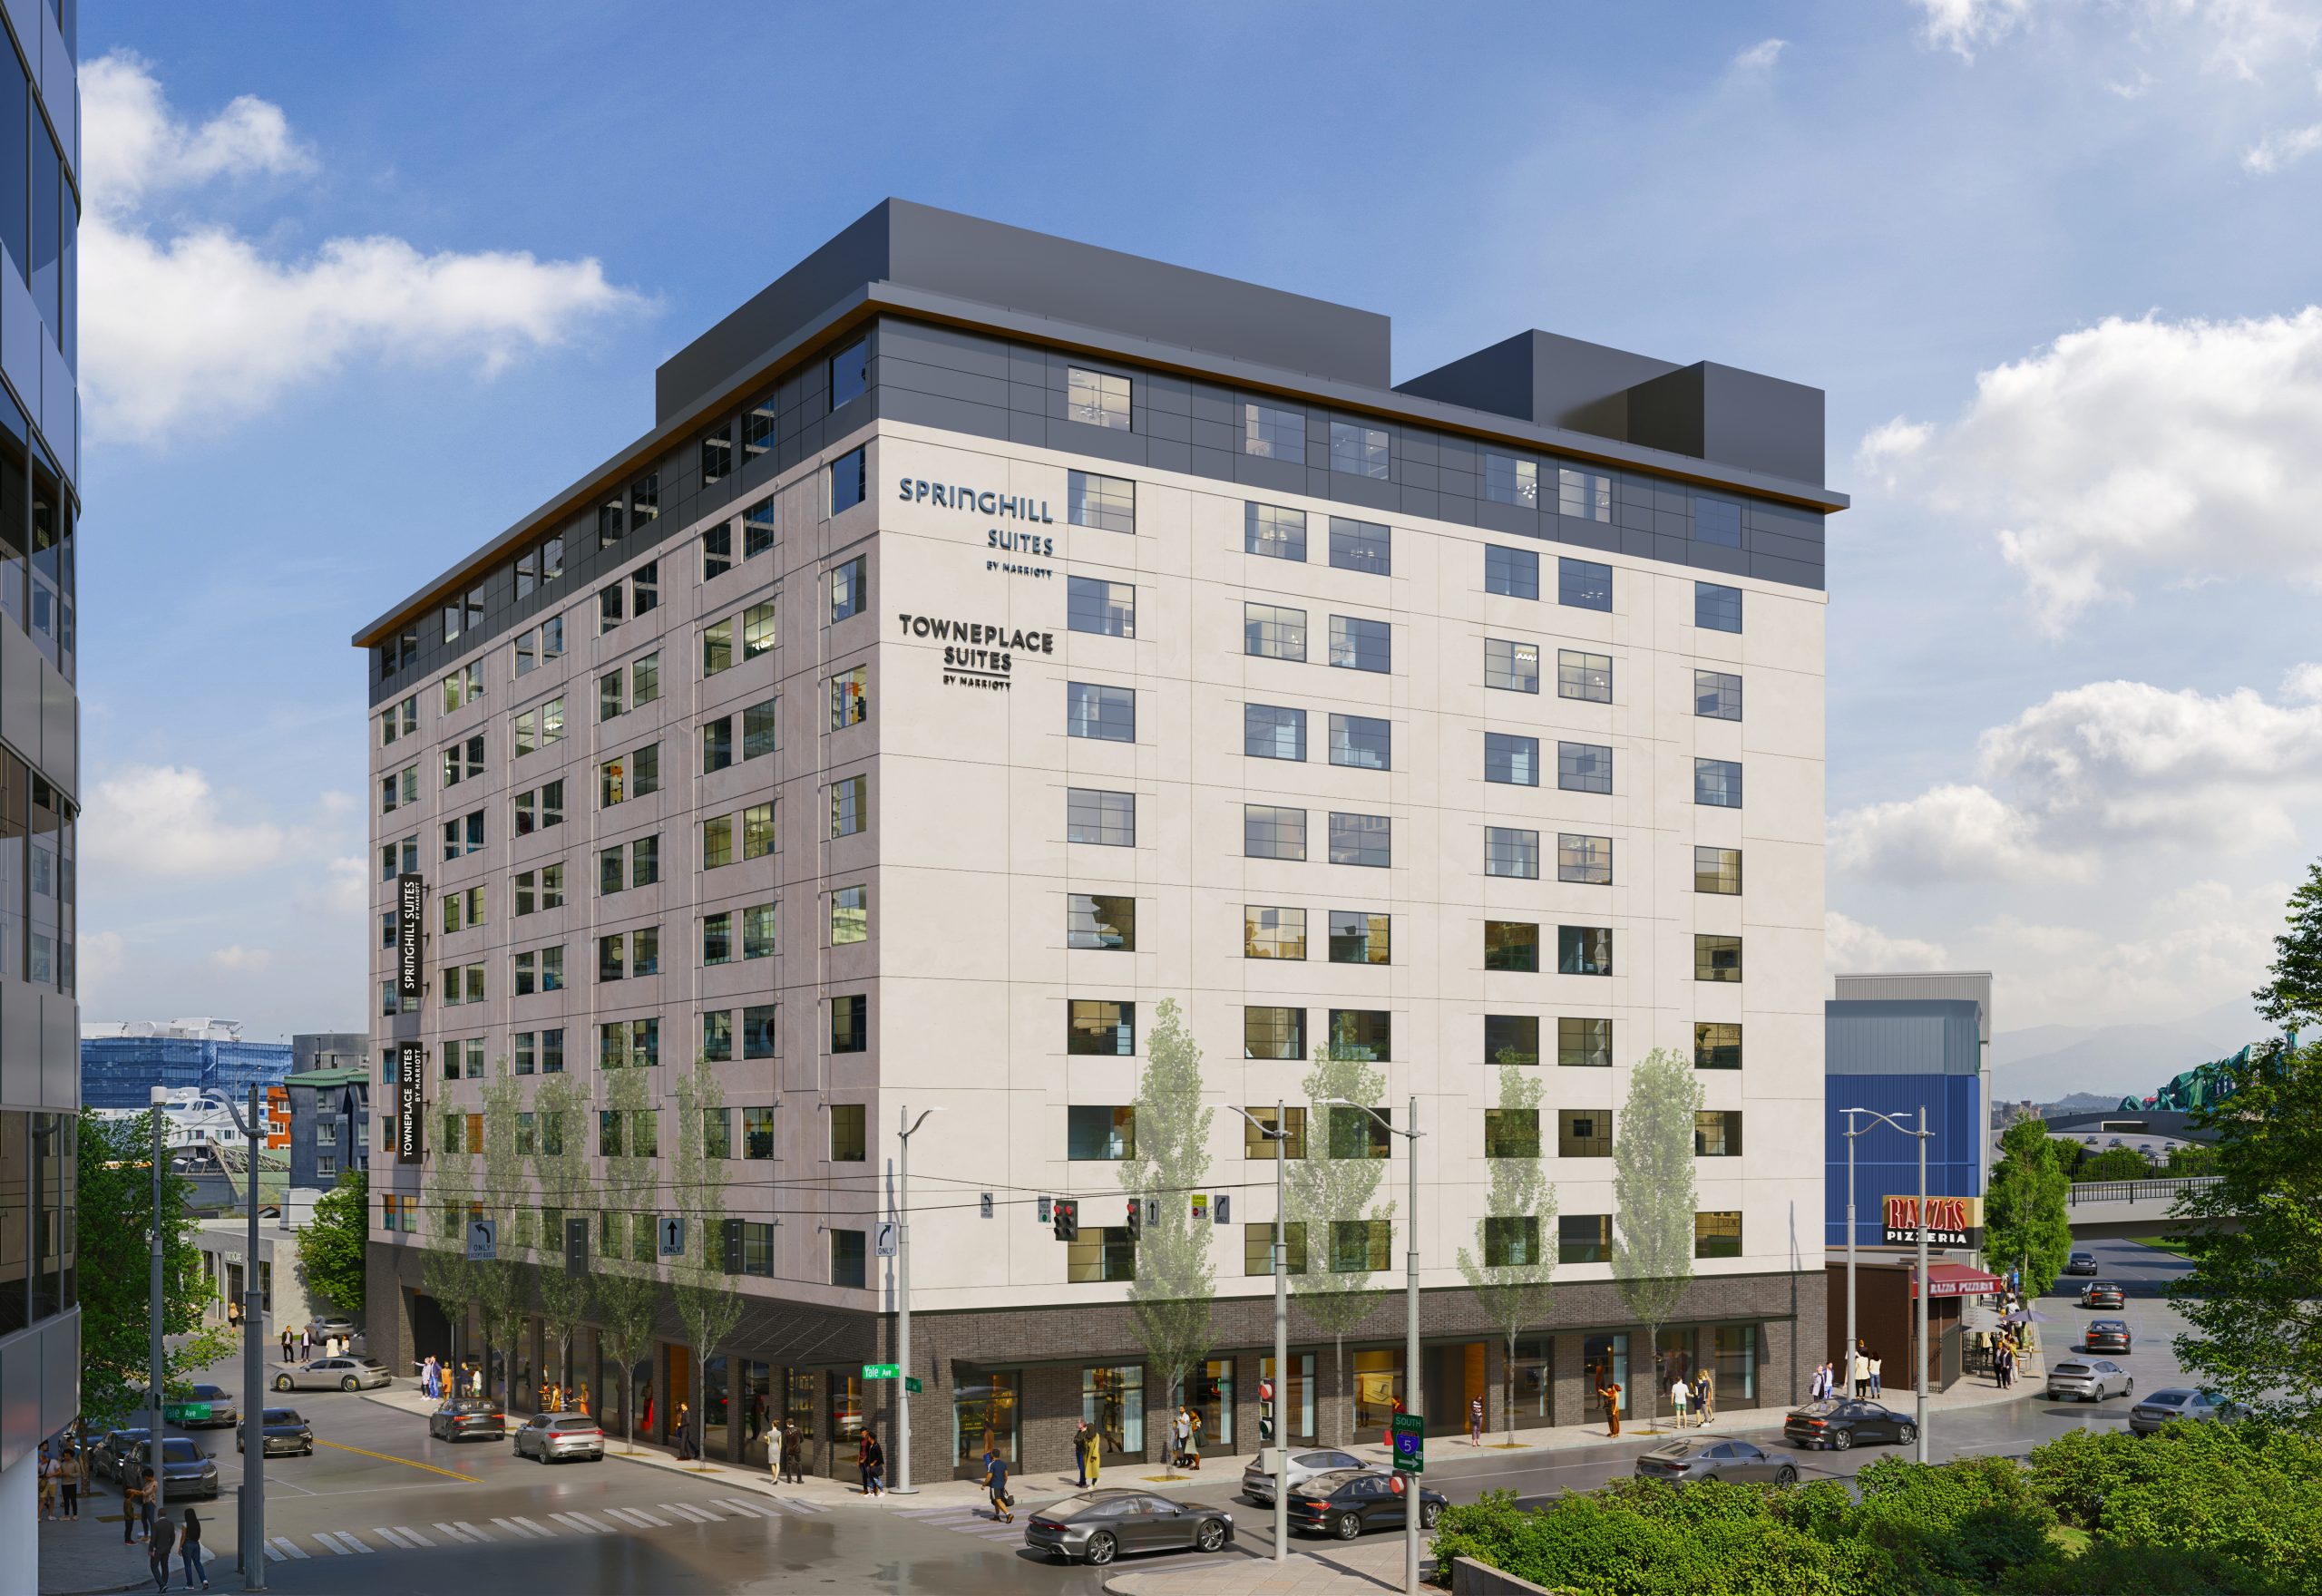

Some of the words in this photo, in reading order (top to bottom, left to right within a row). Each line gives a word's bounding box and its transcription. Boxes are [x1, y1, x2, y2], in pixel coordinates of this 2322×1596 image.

[899, 478, 1053, 523] SPRINGHILL
[988, 529, 1053, 556] SUITES
[987, 560, 999, 571] BY
[1002, 563, 1052, 580] MARRIOTT
[899, 614, 1053, 653] TOWNEPLACE
[944, 646, 1011, 672] SUITES
[943, 675, 956, 685] BY
[960, 676, 1011, 692] MARRIOTT
[405, 881, 415, 919] SUITES
[405, 922, 415, 988] SPRINGHILL
[404, 1049, 412, 1082] SUITES
[415, 1092, 420, 1102] BY
[404, 1088, 412, 1156] TOWNEPLACE
[1887, 1231, 1966, 1243] PIZERIA
[864, 1365, 878, 1377] Yale
[882, 1368, 892, 1377] Ave
[163, 1406, 180, 1418] Yale
[184, 1409, 196, 1417] Ave
[1396, 1416, 1421, 1427] SOUTH
[1404, 1439, 1411, 1452] 5
